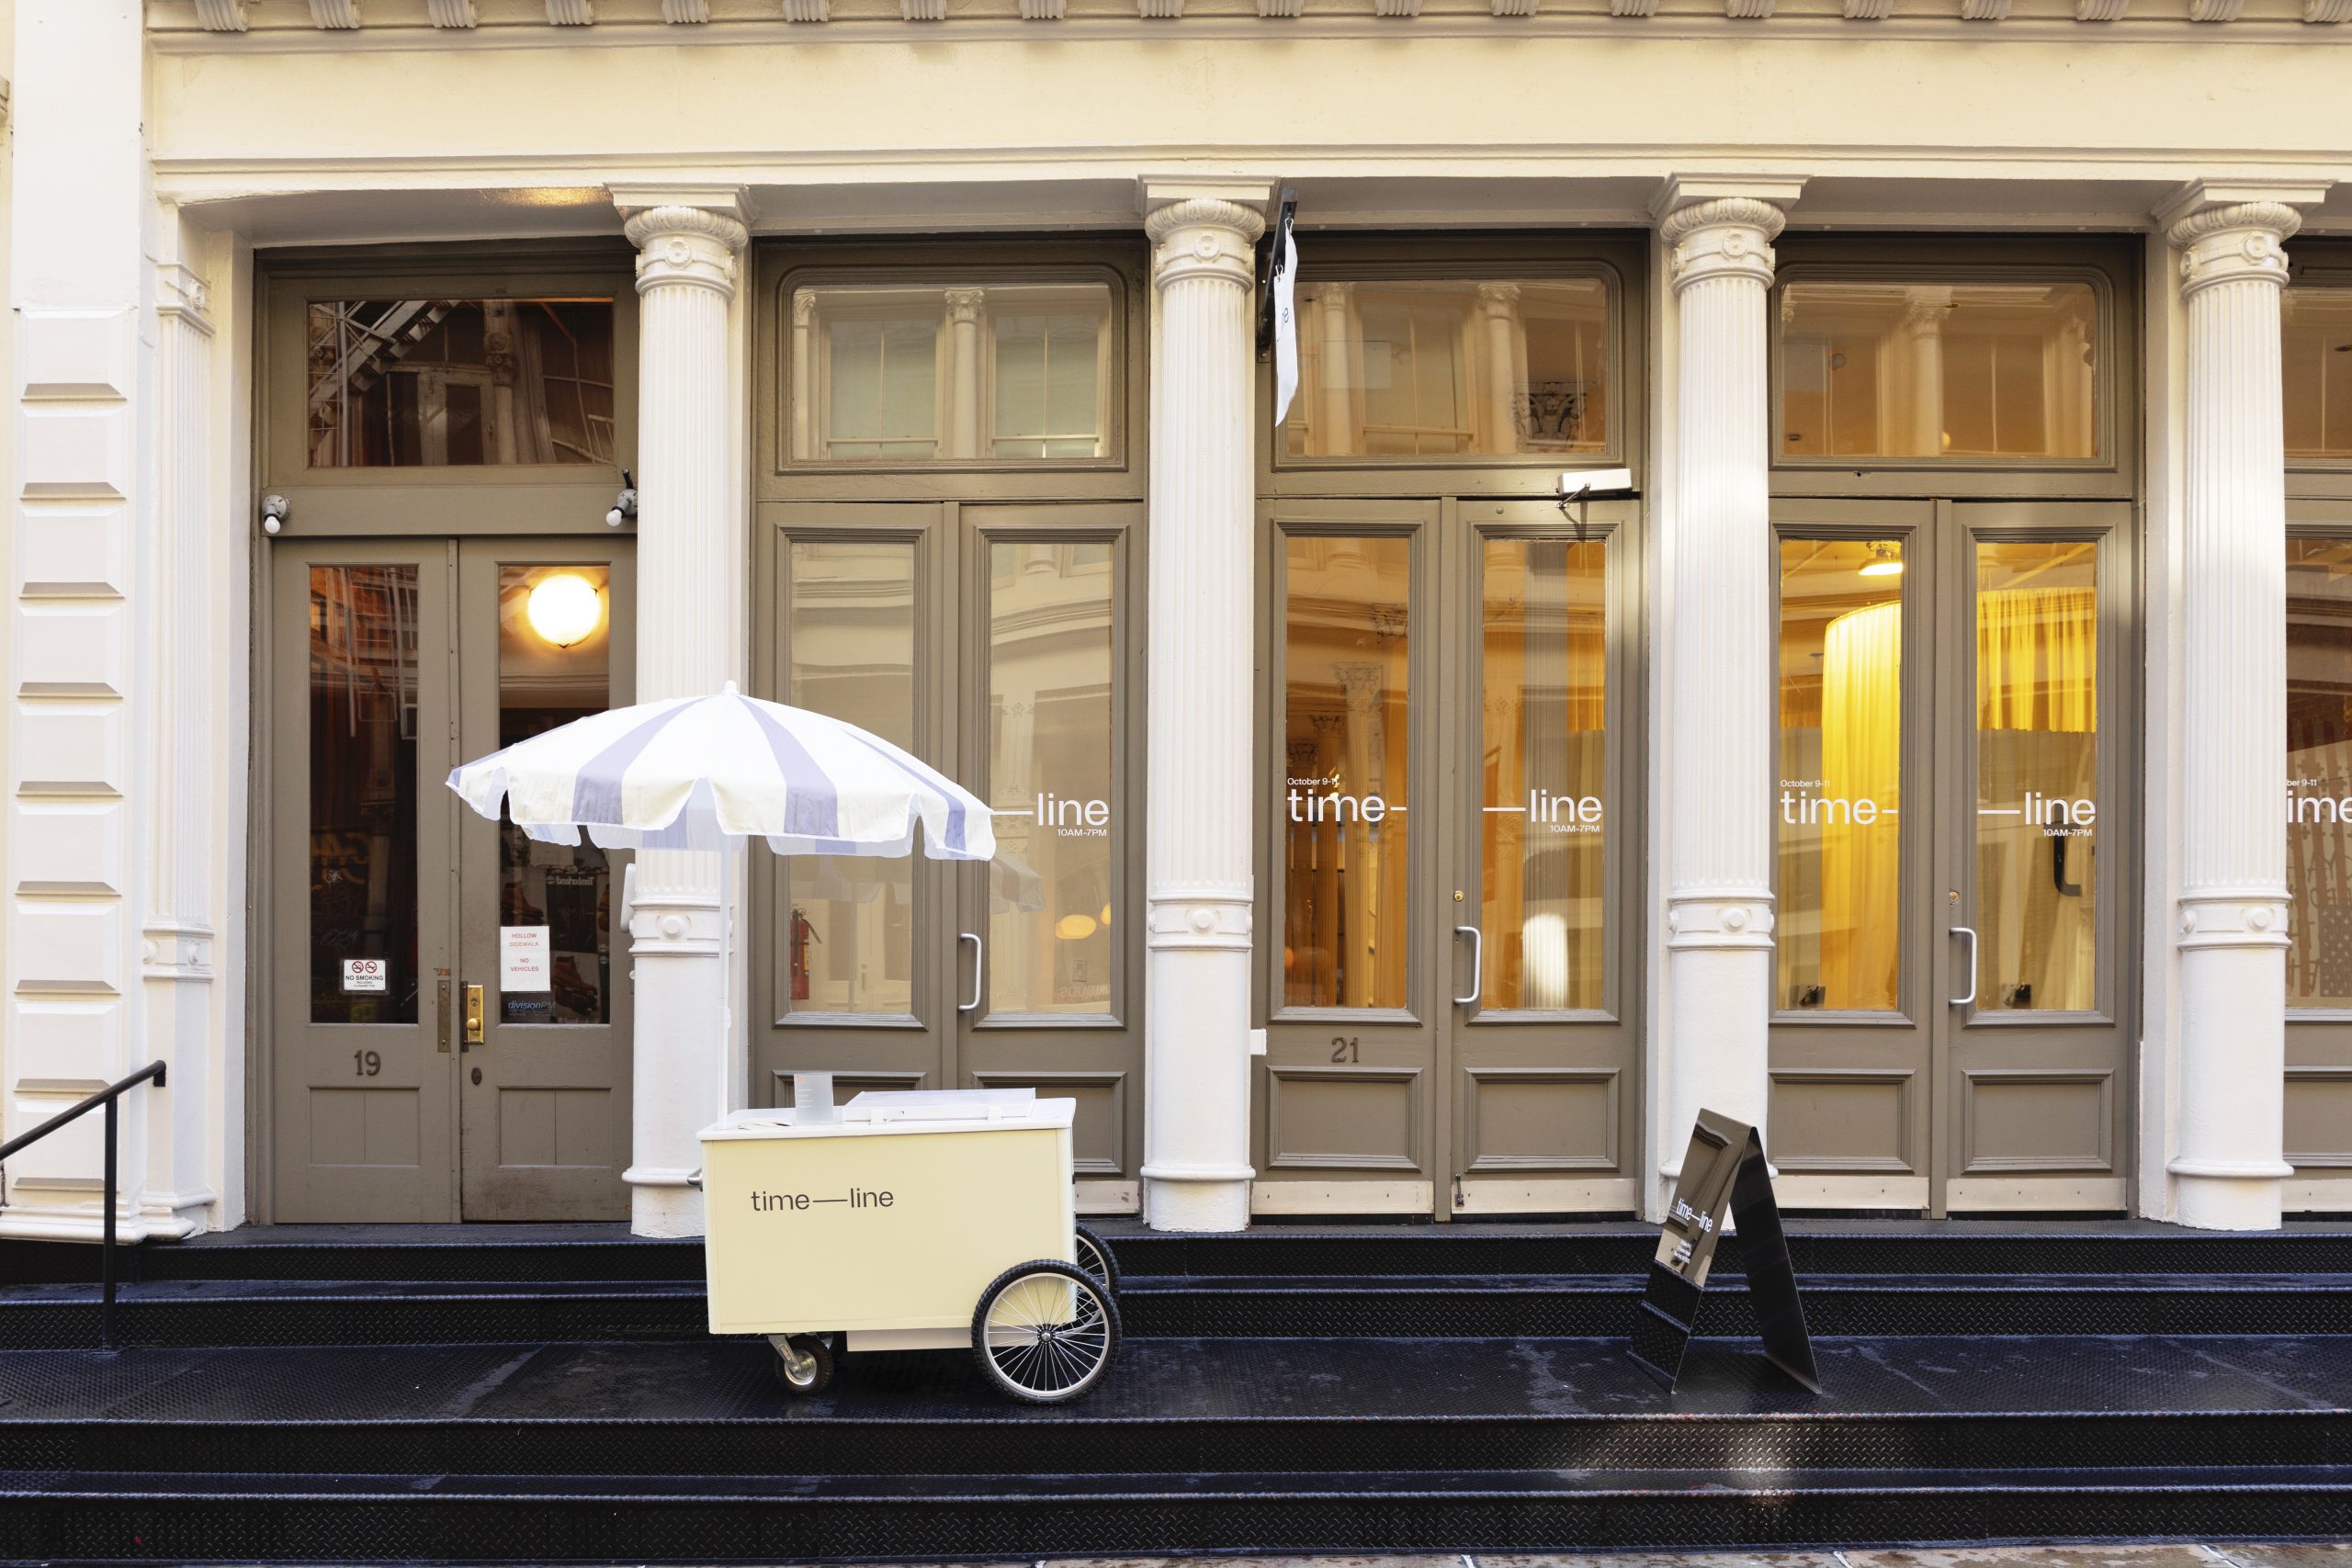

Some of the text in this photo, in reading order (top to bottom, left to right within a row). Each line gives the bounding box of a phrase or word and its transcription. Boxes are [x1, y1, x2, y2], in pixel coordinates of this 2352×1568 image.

[1287, 777, 1320, 785] October
[1781, 779, 1813, 787] October
[2287, 790, 2352, 823] ime
[1057, 829, 1107, 837] 10AM-7PM
[2043, 829, 2093, 837] 10AM-7PM
[1331, 1037, 1359, 1063] 21
[354, 1049, 381, 1076] 19
